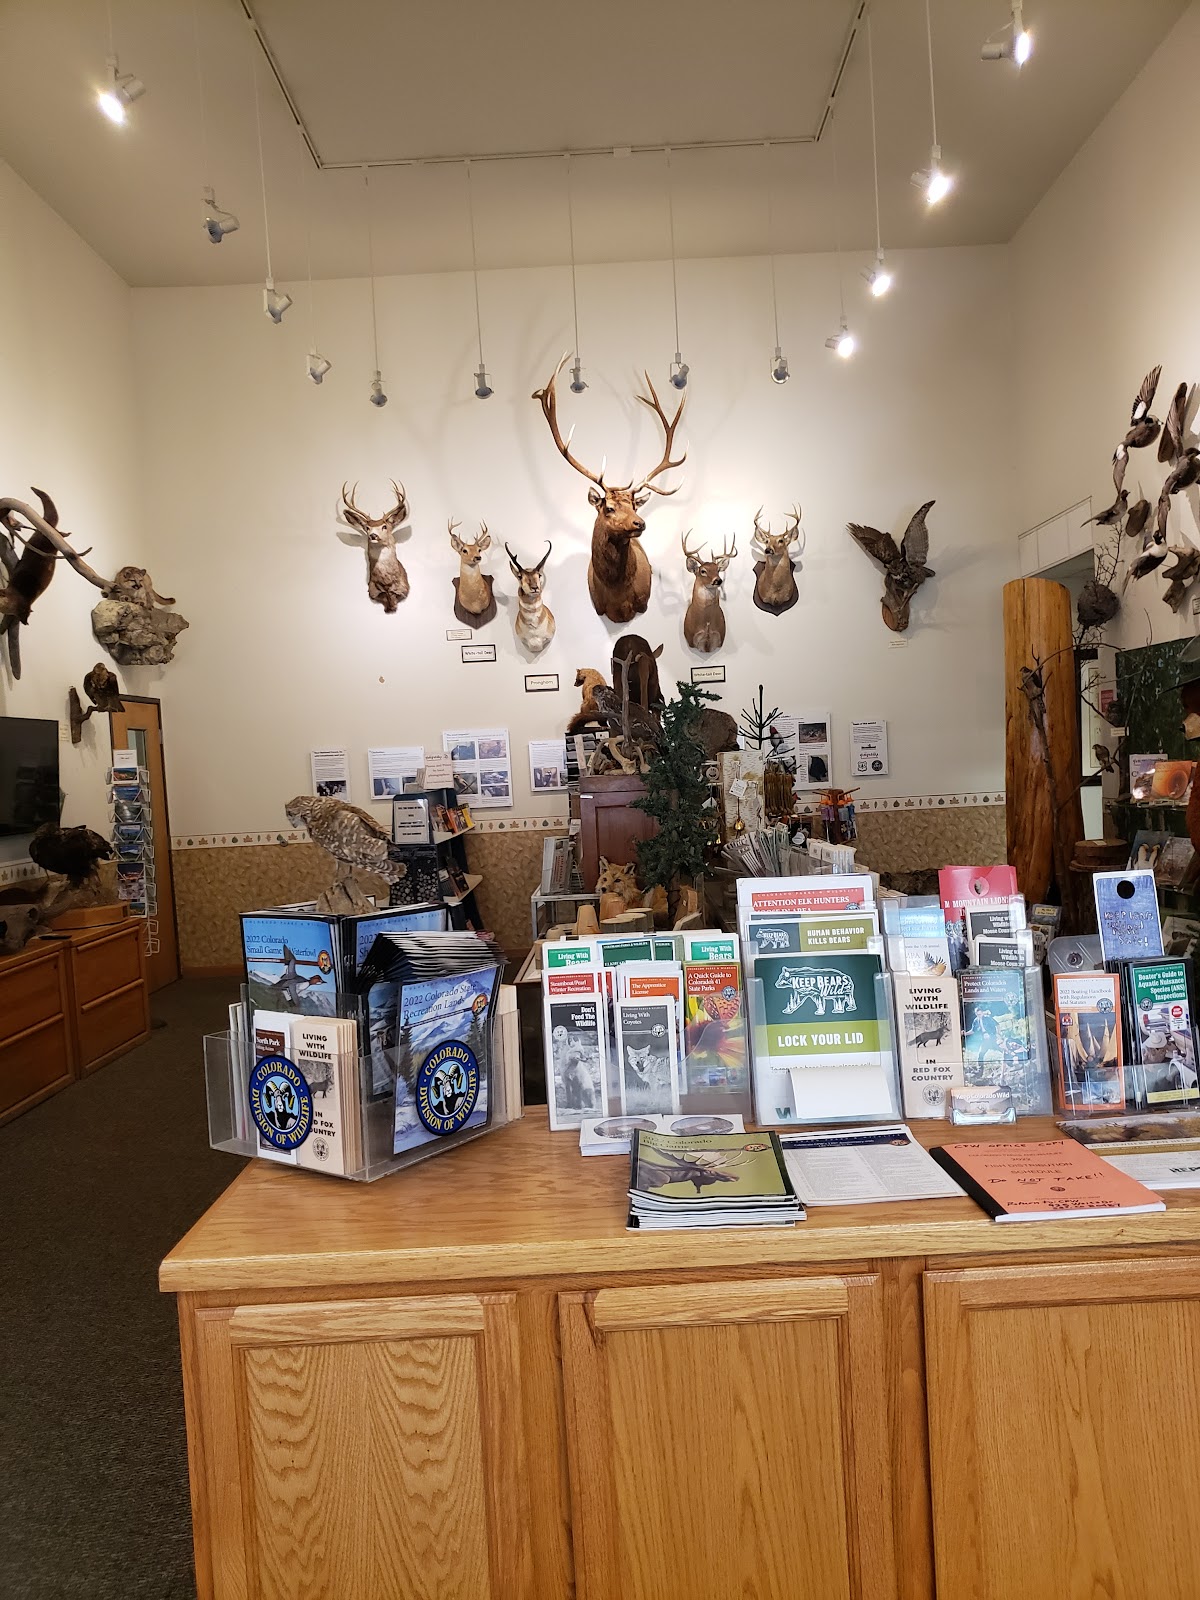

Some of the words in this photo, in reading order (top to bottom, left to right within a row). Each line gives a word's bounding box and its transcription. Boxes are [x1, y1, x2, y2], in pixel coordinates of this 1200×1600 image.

[754, 898, 796, 907] ATTENTION
[813, 896, 849, 904] HUNTERS
[952, 897, 988, 908] MOUNTAIN
[807, 929, 830, 937] HUMAN
[832, 927, 864, 936] BEHAVIOR
[261, 935, 288, 944] Colorado
[829, 936, 850, 944] BEARS
[247, 946, 264, 954] Small
[265, 947, 282, 955] Game
[709, 952, 732, 960] Bears
[1138, 972, 1160, 980] Boater's
[792, 976, 816, 989] KEEP
[817, 975, 848, 986] BEARS
[820, 984, 846, 997] Wild
[1171, 984, 1185, 992] (ANS)
[404, 997, 423, 1007] 2022
[425, 986, 458, 1000] Colorado
[403, 1003, 441, 1020] Recreation
[444, 995, 465, 1009] Lands
[256, 1037, 268, 1045] North
[269, 1038, 281, 1046] Park
[302, 1033, 327, 1042] LIVING
[777, 1034, 807, 1047] LOCK
[811, 1033, 841, 1046] YOUR
[845, 1032, 864, 1044] LID
[306, 1042, 325, 1050] WITH
[299, 1050, 332, 1060] WILDLIFE
[425, 1047, 469, 1076] COLORADO
[256, 1062, 301, 1087] COLORADO
[420, 1086, 442, 1130] DIVISION
[444, 1118, 454, 1130] OF
[456, 1068, 476, 1122] WILDLIFE
[252, 1088, 274, 1138] DIVISION
[275, 1133, 286, 1145] OF
[287, 1095, 310, 1144] WILDLIFE
[320, 1120, 334, 1128] FOX
[309, 1128, 336, 1137] OUNTRY
[1054, 1172, 1104, 1181] TAKE!!
